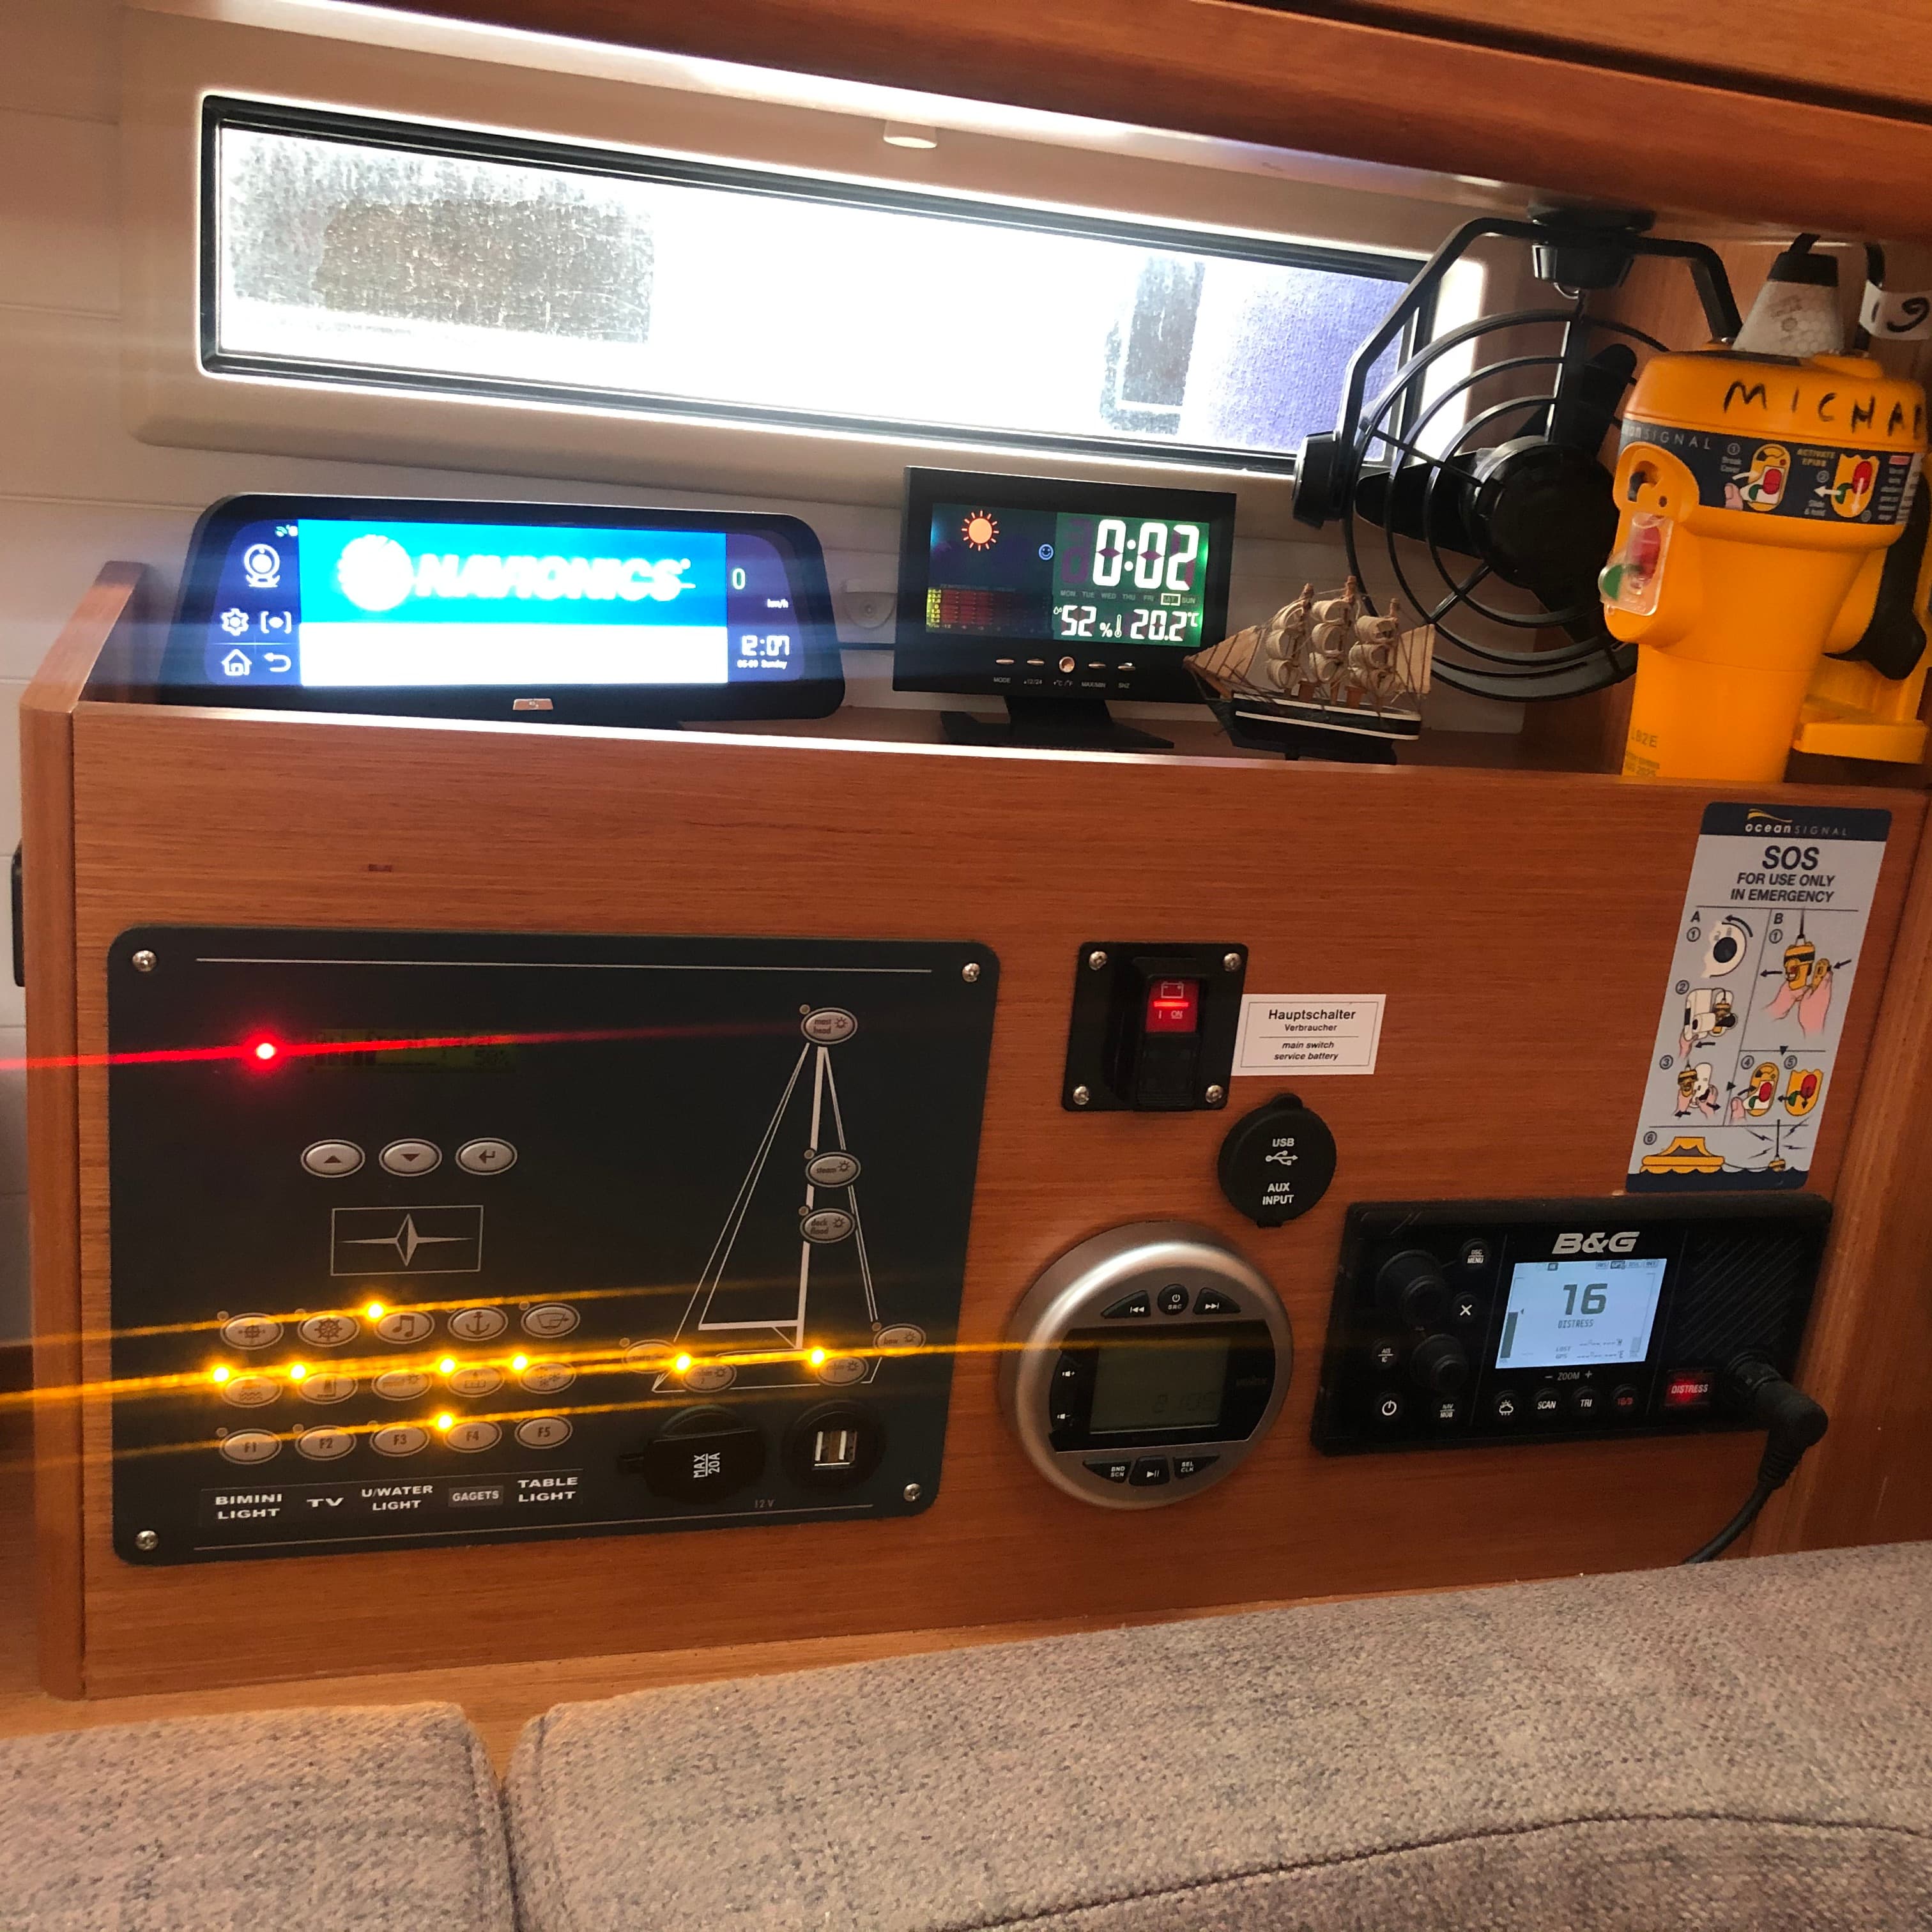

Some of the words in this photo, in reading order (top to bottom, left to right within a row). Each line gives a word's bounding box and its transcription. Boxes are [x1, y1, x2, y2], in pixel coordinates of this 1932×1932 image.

[1092, 519, 1200, 591] 0:02
[732, 568, 746, 590] 0
[1101, 592, 1117, 600] WED
[1061, 605, 1097, 637] 52
[1762, 845, 1820, 870] SOS
[1736, 872, 1765, 885] FOR
[1768, 873, 1797, 885] USE
[1799, 874, 1835, 887] ONLY
[1730, 889, 1745, 900] IN
[1748, 889, 1835, 902] EMERGENCY
[1690, 910, 1701, 923] A
[1774, 912, 1783, 924] B
[1268, 1009, 1356, 1022] Hauptschalter
[1308, 1053, 1339, 1061] battery
[1272, 1138, 1295, 1147] USB
[1267, 1183, 1291, 1192] AUX
[1262, 1194, 1294, 1206] INPUT
[811, 1218, 828, 1226] deck
[1552, 1231, 1641, 1254] B&G
[1563, 1283, 1608, 1315] 16
[1558, 1319, 1595, 1329] DISTRESS
[1557, 1372, 1580, 1381] ZOOM
[1671, 1384, 1709, 1394] DISTRESS
[1537, 1400, 1556, 1409] SCAN
[1580, 1399, 1593, 1407] TRI
[466, 1430, 480, 1441] F4
[537, 1427, 551, 1437] F5
[319, 1438, 333, 1449] F2
[393, 1434, 407, 1445] F3
[244, 1441, 257, 1453] F1
[693, 1453, 706, 1478] MAX
[708, 1452, 721, 1474] 20A
[517, 1476, 578, 1488] TABLE
[361, 1485, 433, 1498] U/WATER
[452, 1490, 500, 1501] GAGETS
[518, 1491, 576, 1502] LIGHT
[215, 1493, 282, 1505] BIMINI
[306, 1497, 344, 1508] TV
[372, 1500, 422, 1511] LIGHT
[217, 1508, 281, 1519] LIGHT
